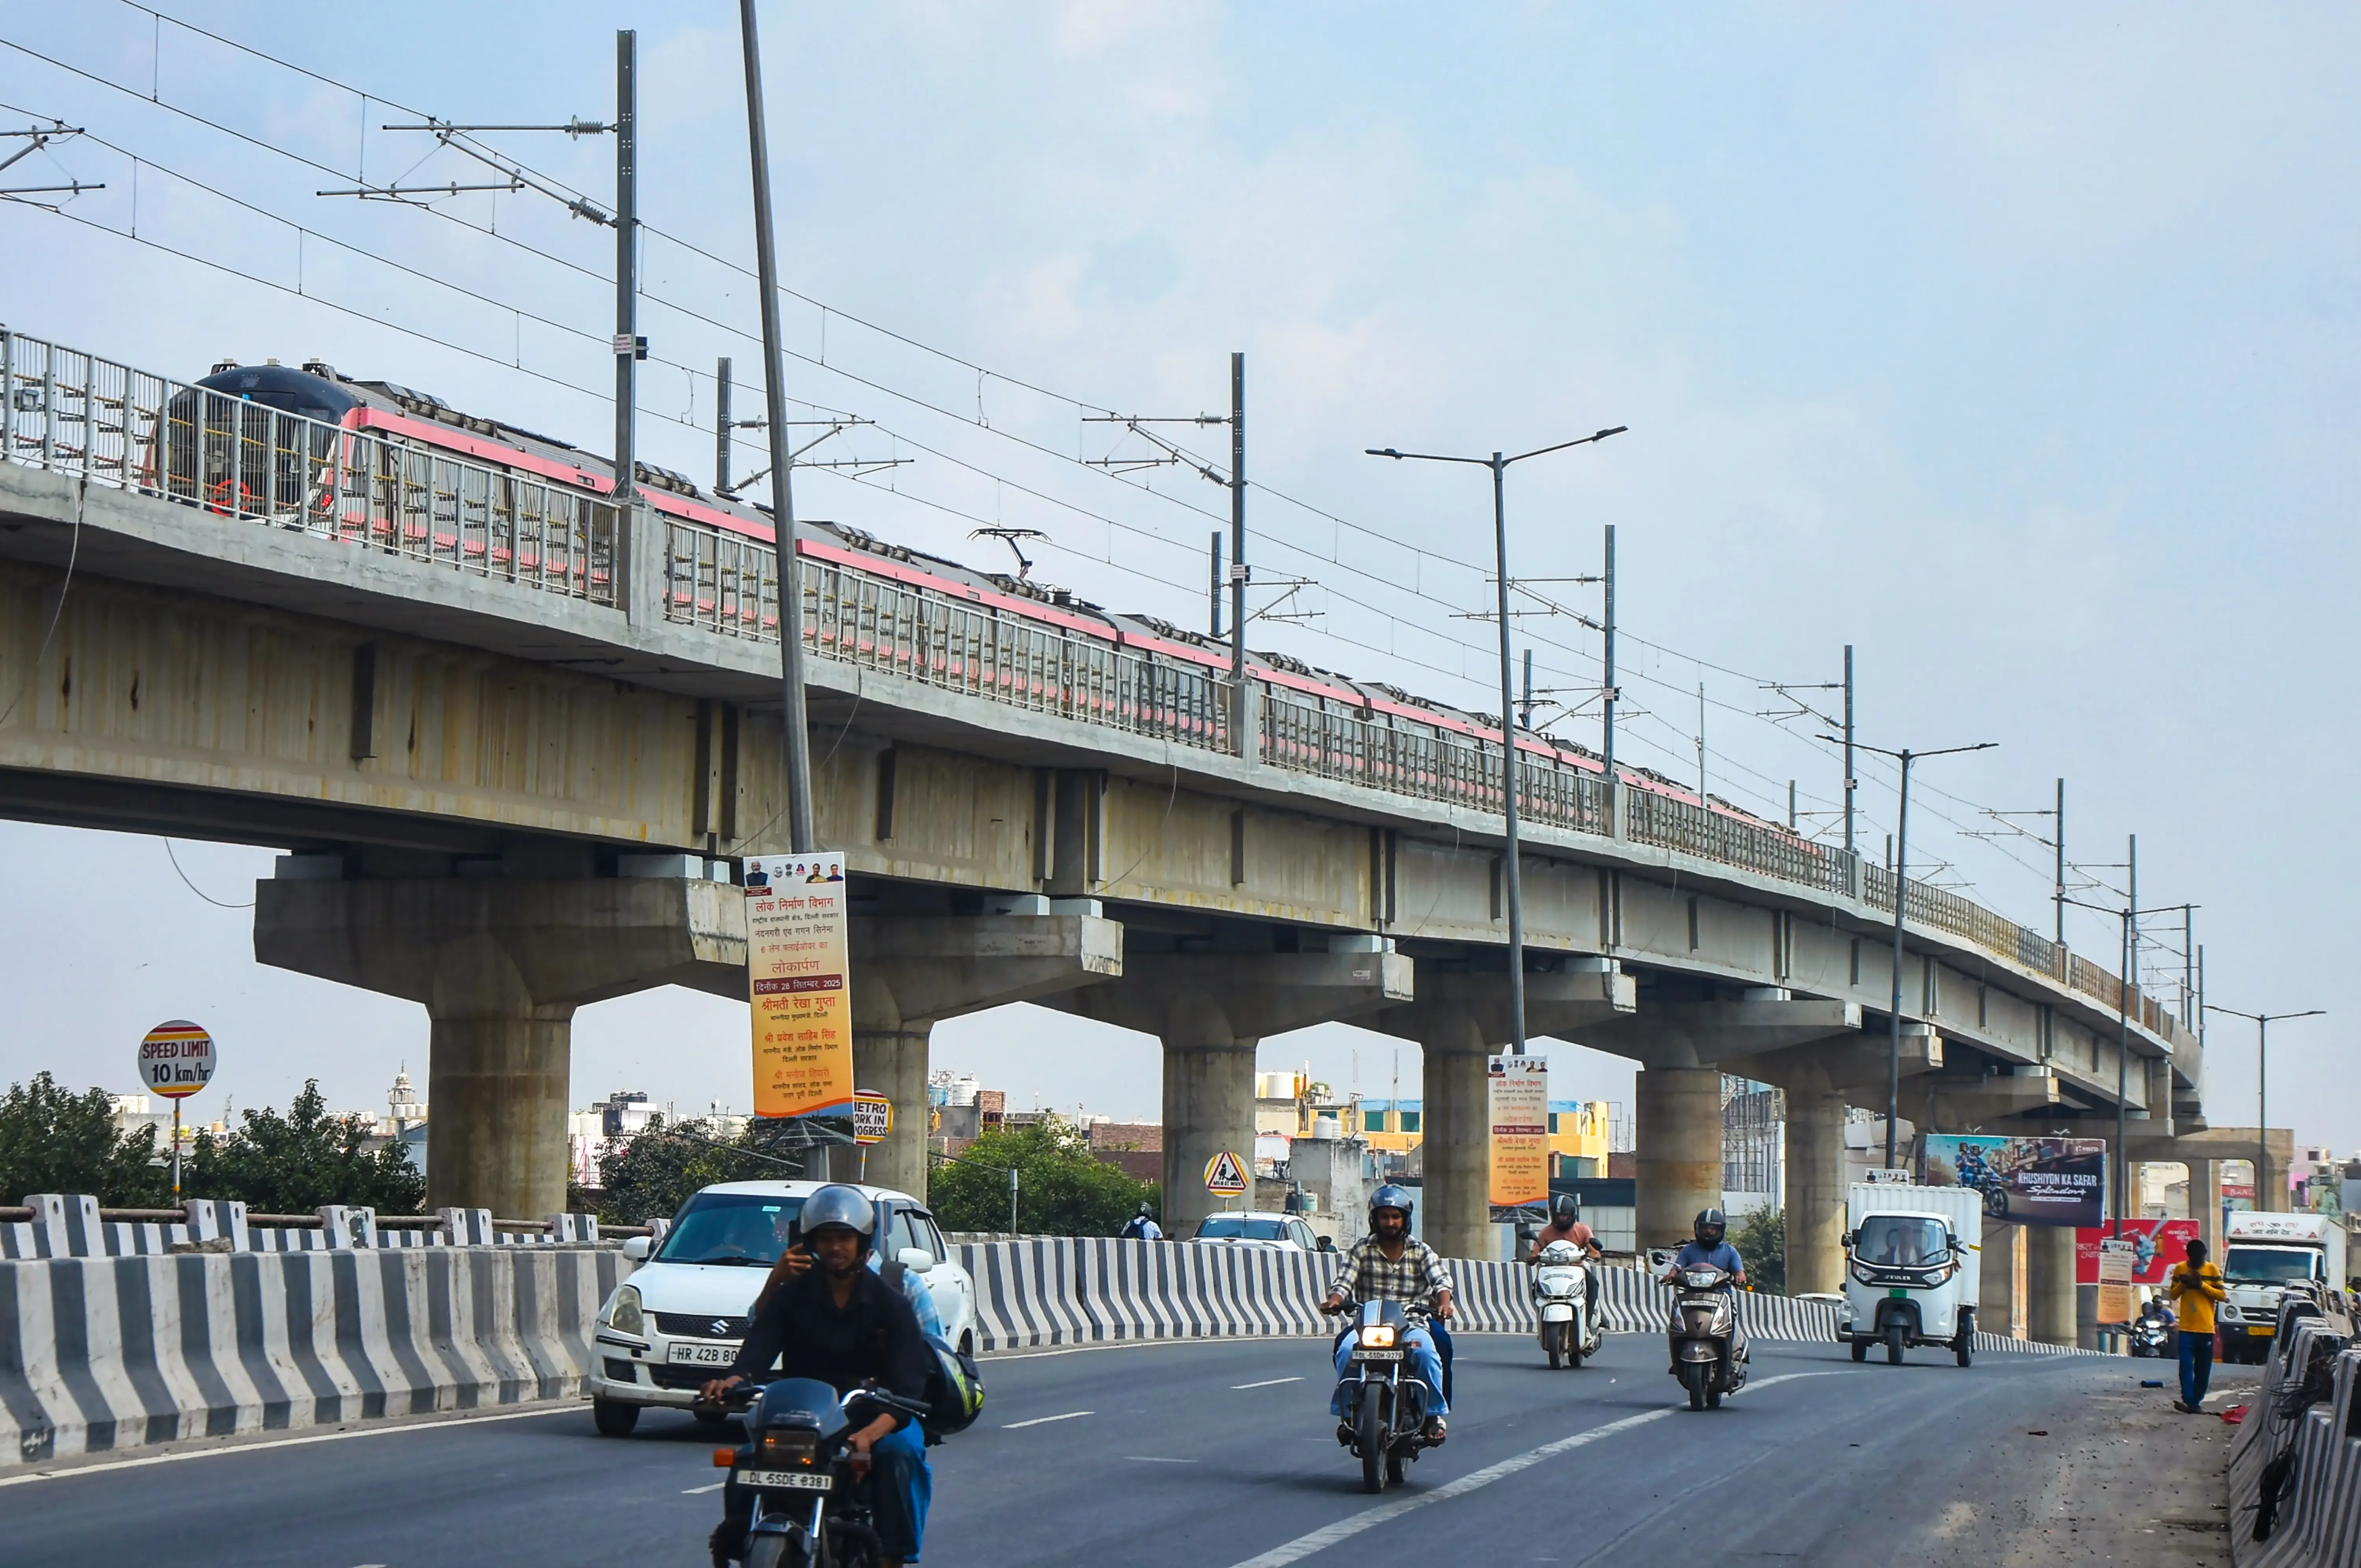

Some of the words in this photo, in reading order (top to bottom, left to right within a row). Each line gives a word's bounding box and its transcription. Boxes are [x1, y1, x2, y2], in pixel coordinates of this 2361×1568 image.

[755, 899, 774, 912] लोक
[779, 897, 804, 910] निर्माण
[809, 896, 833, 908] विभाग
[755, 927, 780, 937] नंदनगरी
[814, 924, 833, 934] सिनेमा
[769, 943, 780, 953] लेन
[771, 958, 820, 973] लोकार्पण
[762, 997, 788, 1010] श्रीमती
[793, 995, 811, 1008] रेखा
[815, 997, 835, 1011] गुप्ता
[765, 1032, 773, 1043] श्री
[777, 1031, 793, 1042] प्रवेश
[797, 1030, 818, 1041] साहिब
[822, 1029, 836, 1040] सिंह
[143, 1042, 178, 1059] SPEED
[181, 1041, 210, 1058] LIMIT
[152, 1063, 170, 1082] 10
[175, 1062, 211, 1082] km/hr
[774, 1069, 783, 1080] श्री
[786, 1068, 805, 1079] मनोज
[809, 1067, 829, 1077] तिवारी
[855, 1114, 871, 1124] ORK
[874, 1116, 885, 1125] IN
[855, 1125, 888, 1136] OGRESS
[2018, 1172, 2060, 1185] KHUSHIYON
[2062, 1174, 2072, 1186] KA
[2073, 1174, 2097, 1187] SAFAR
[677, 1348, 692, 1361] HR
[696, 1348, 719, 1362] 42B
[723, 1350, 738, 1362] 80
[749, 1472, 762, 1483] DL
